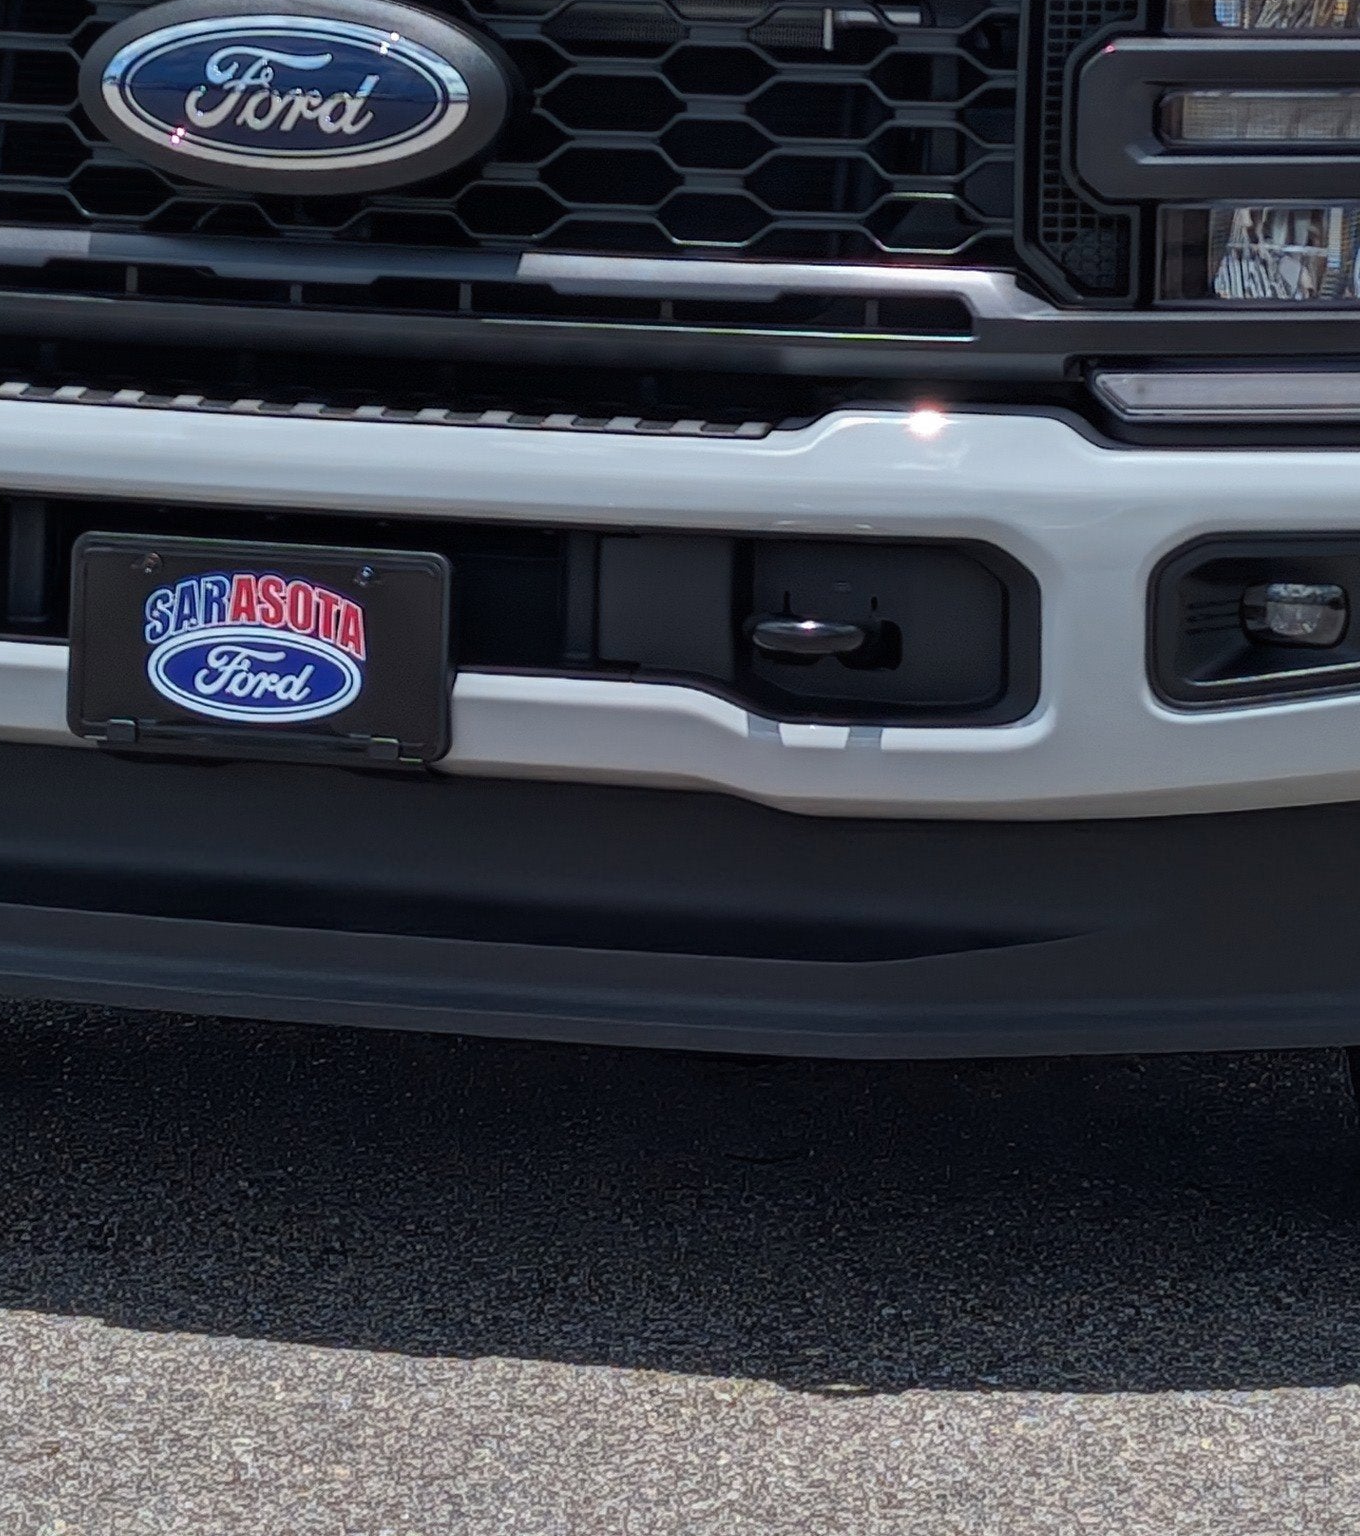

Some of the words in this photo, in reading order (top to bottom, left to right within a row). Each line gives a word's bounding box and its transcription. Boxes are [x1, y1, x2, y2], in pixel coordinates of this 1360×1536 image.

[184, 45, 380, 135] Ford
[144, 572, 367, 662] SARASOTA
[193, 645, 316, 703] Ford
